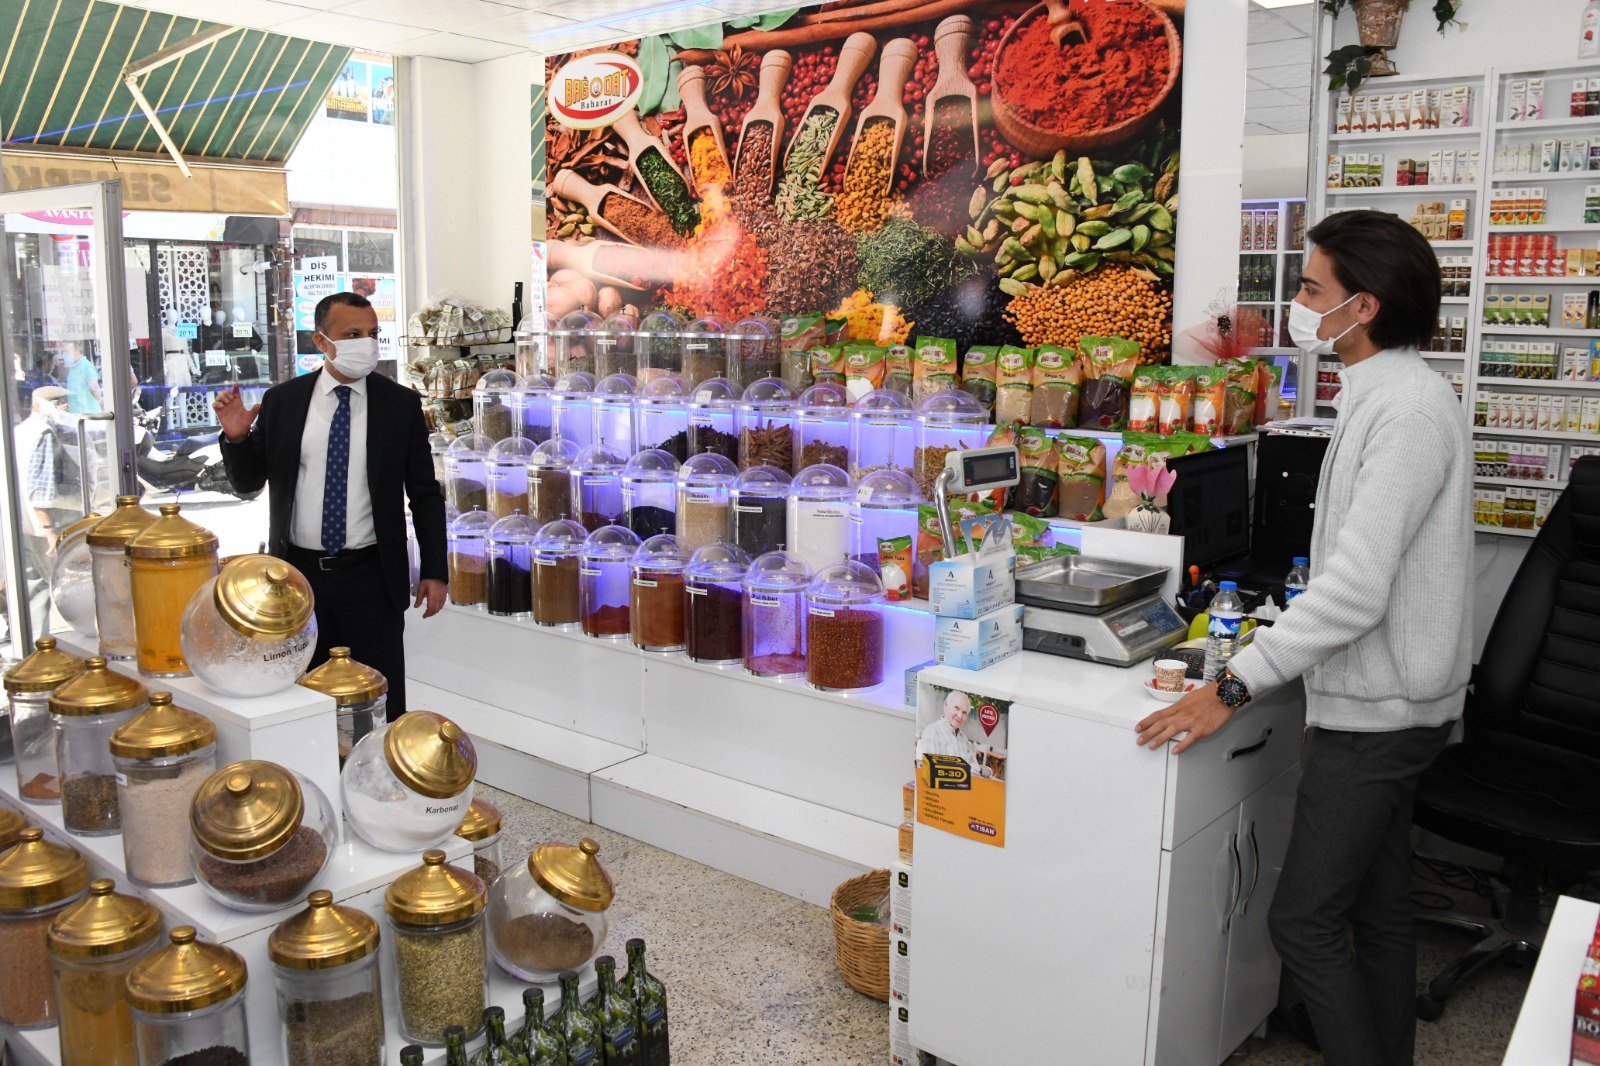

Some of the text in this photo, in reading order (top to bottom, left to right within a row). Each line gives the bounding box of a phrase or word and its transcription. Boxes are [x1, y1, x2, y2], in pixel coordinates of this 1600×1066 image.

[581, 99, 612, 109] Baharat
[311, 261, 327, 270] DİŞ
[304, 273, 335, 282] HEKİMİ
[263, 649, 292, 662] Limon
[425, 804, 459, 814] Karbonat
